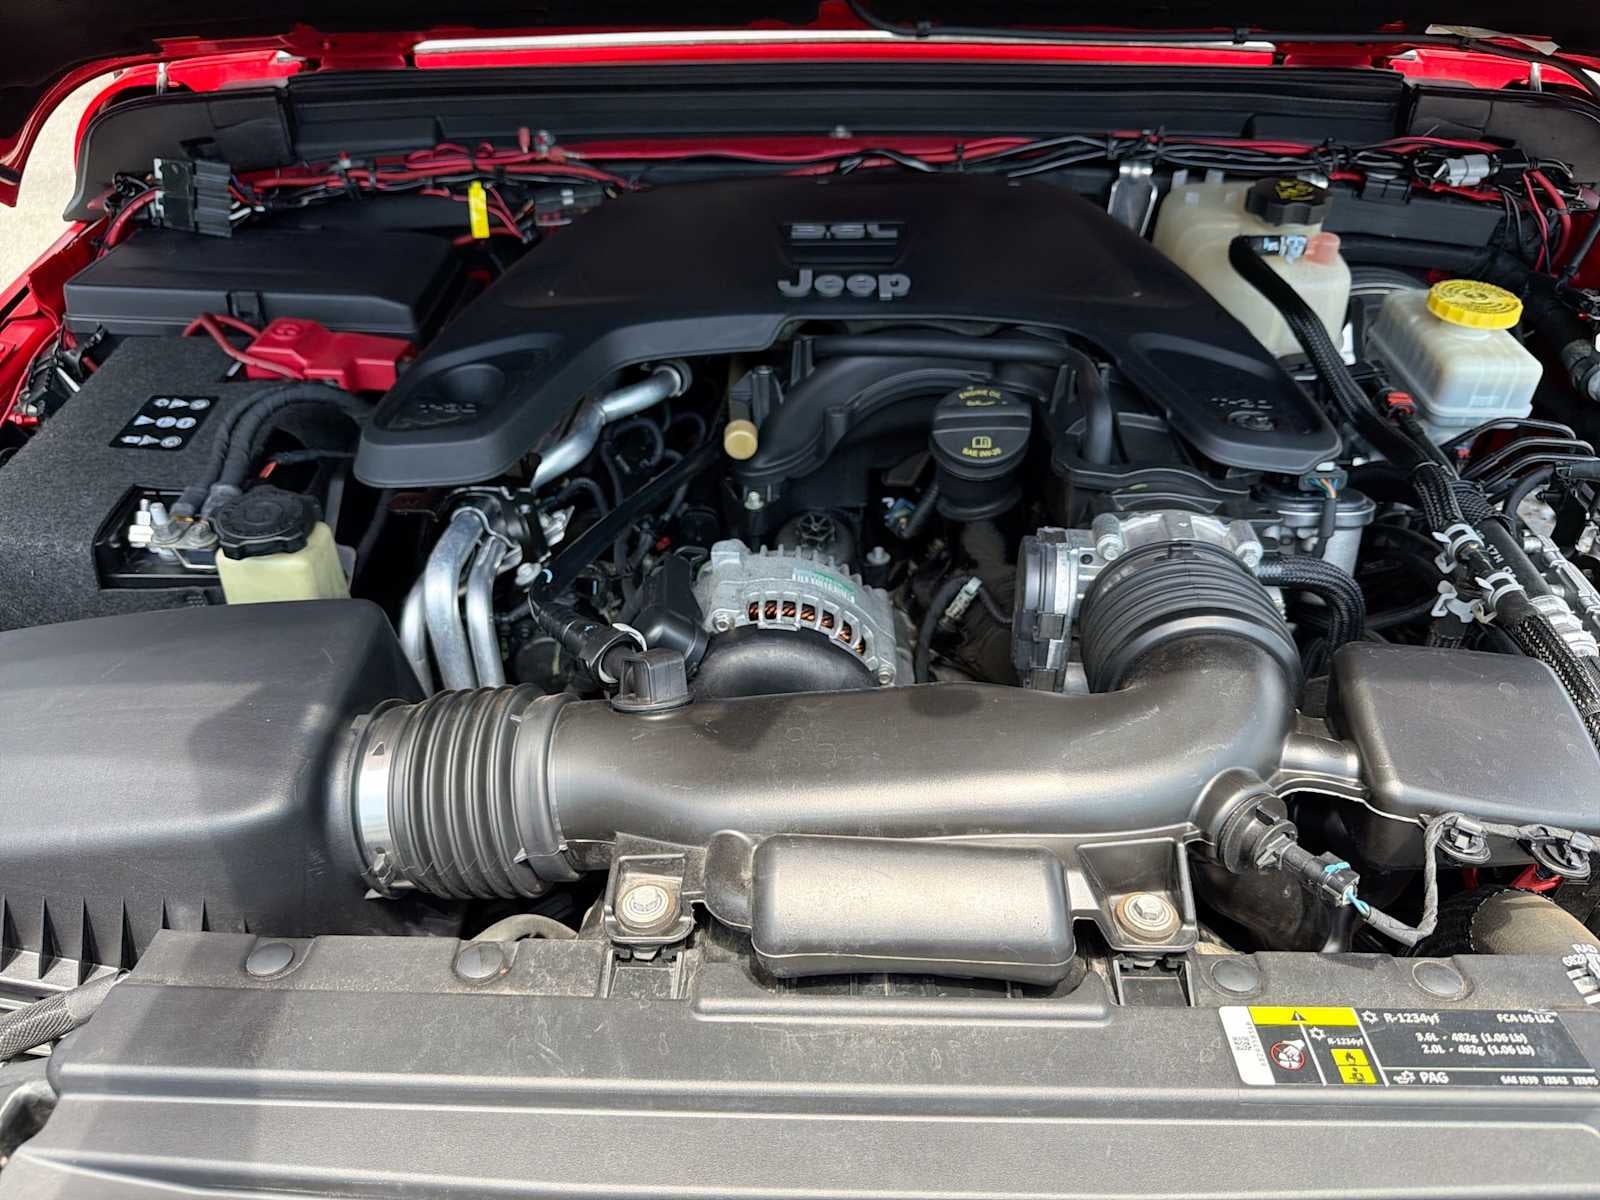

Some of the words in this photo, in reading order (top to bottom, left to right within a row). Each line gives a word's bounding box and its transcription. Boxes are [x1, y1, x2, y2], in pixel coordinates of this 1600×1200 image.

[777, 269, 911, 301] Jeep
[1383, 1012, 1440, 1026] R-1234yf
[1496, 1013, 1519, 1023] FCA
[1518, 1013, 1535, 1023] US
[1534, 1014, 1555, 1023] LLC
[1415, 1032, 1440, 1042] 3.6L
[1451, 1032, 1479, 1044] 482g
[1421, 1043, 1446, 1054] 2.0L
[1457, 1044, 1486, 1056] 482g
[1419, 1071, 1449, 1084] PAG
